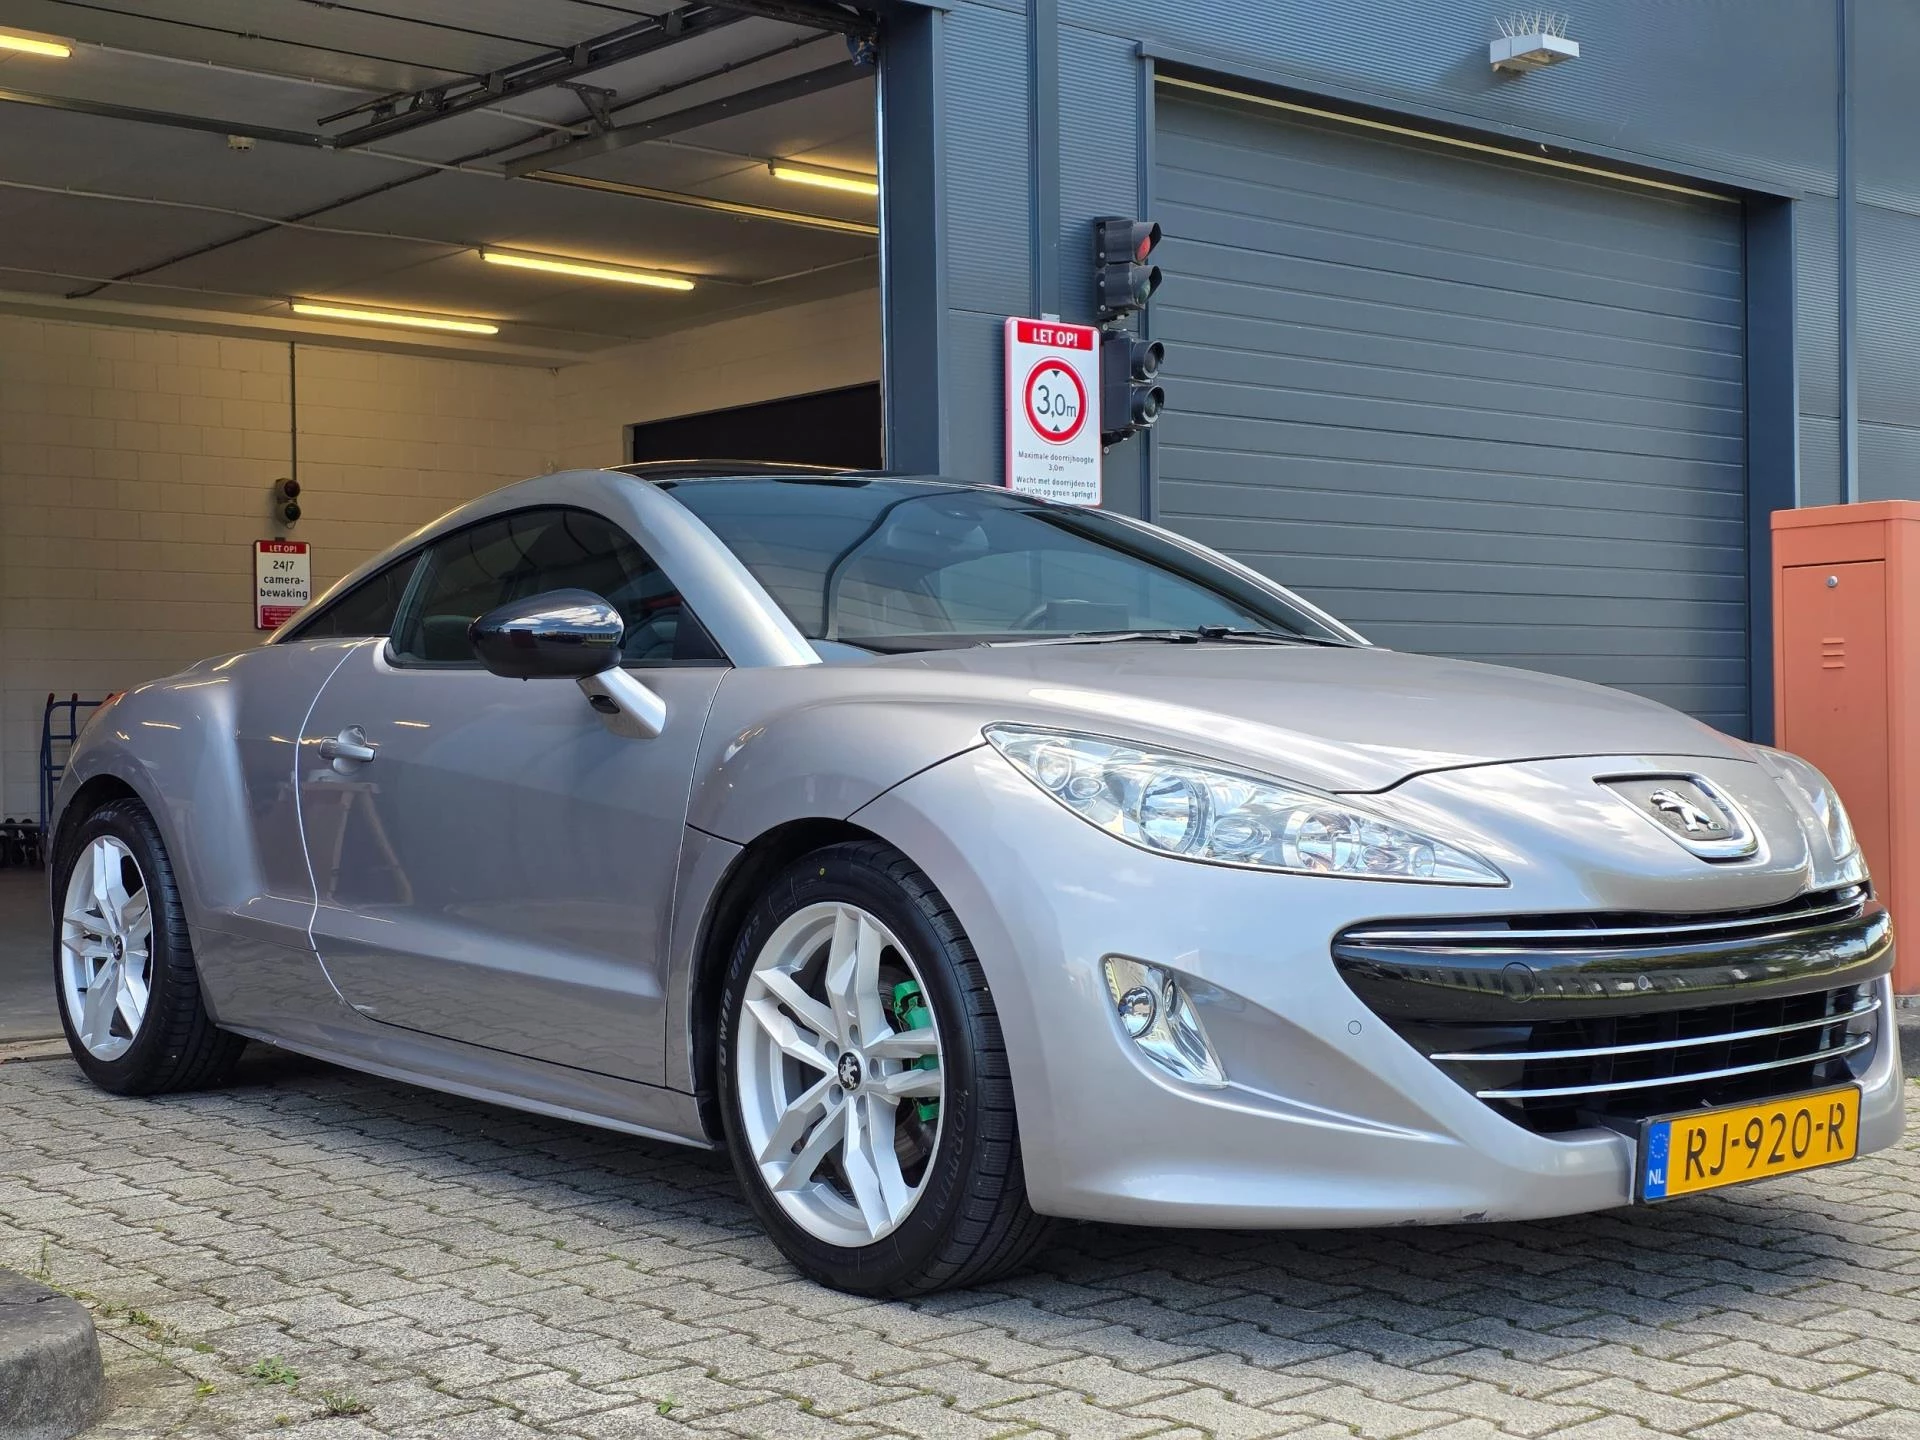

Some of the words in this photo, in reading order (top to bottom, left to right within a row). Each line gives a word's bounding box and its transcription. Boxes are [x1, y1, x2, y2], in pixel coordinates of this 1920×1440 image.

[1033, 327, 1053, 343] LET
[1056, 331, 1078, 347] OP!
[1037, 385, 1077, 418] 3,0m
[1018, 450, 1049, 460] Maximale
[1050, 453, 1095, 465] doorrijhoogte
[1048, 464, 1064, 472] 3,0m
[1016, 475, 1037, 484] Wacht
[1052, 478, 1086, 489] doorrijden
[1028, 486, 1042, 495] licht
[1052, 490, 1070, 498] groen
[1072, 490, 1093, 500] springt
[269, 545, 282, 553] LET
[283, 545, 297, 553] OP!
[272, 560, 295, 572] 24/7
[263, 576, 304, 585] camera-
[260, 588, 308, 600] bewaking
[1684, 1102, 1846, 1182] RJ-920-R
[1648, 1168, 1665, 1186] NL
